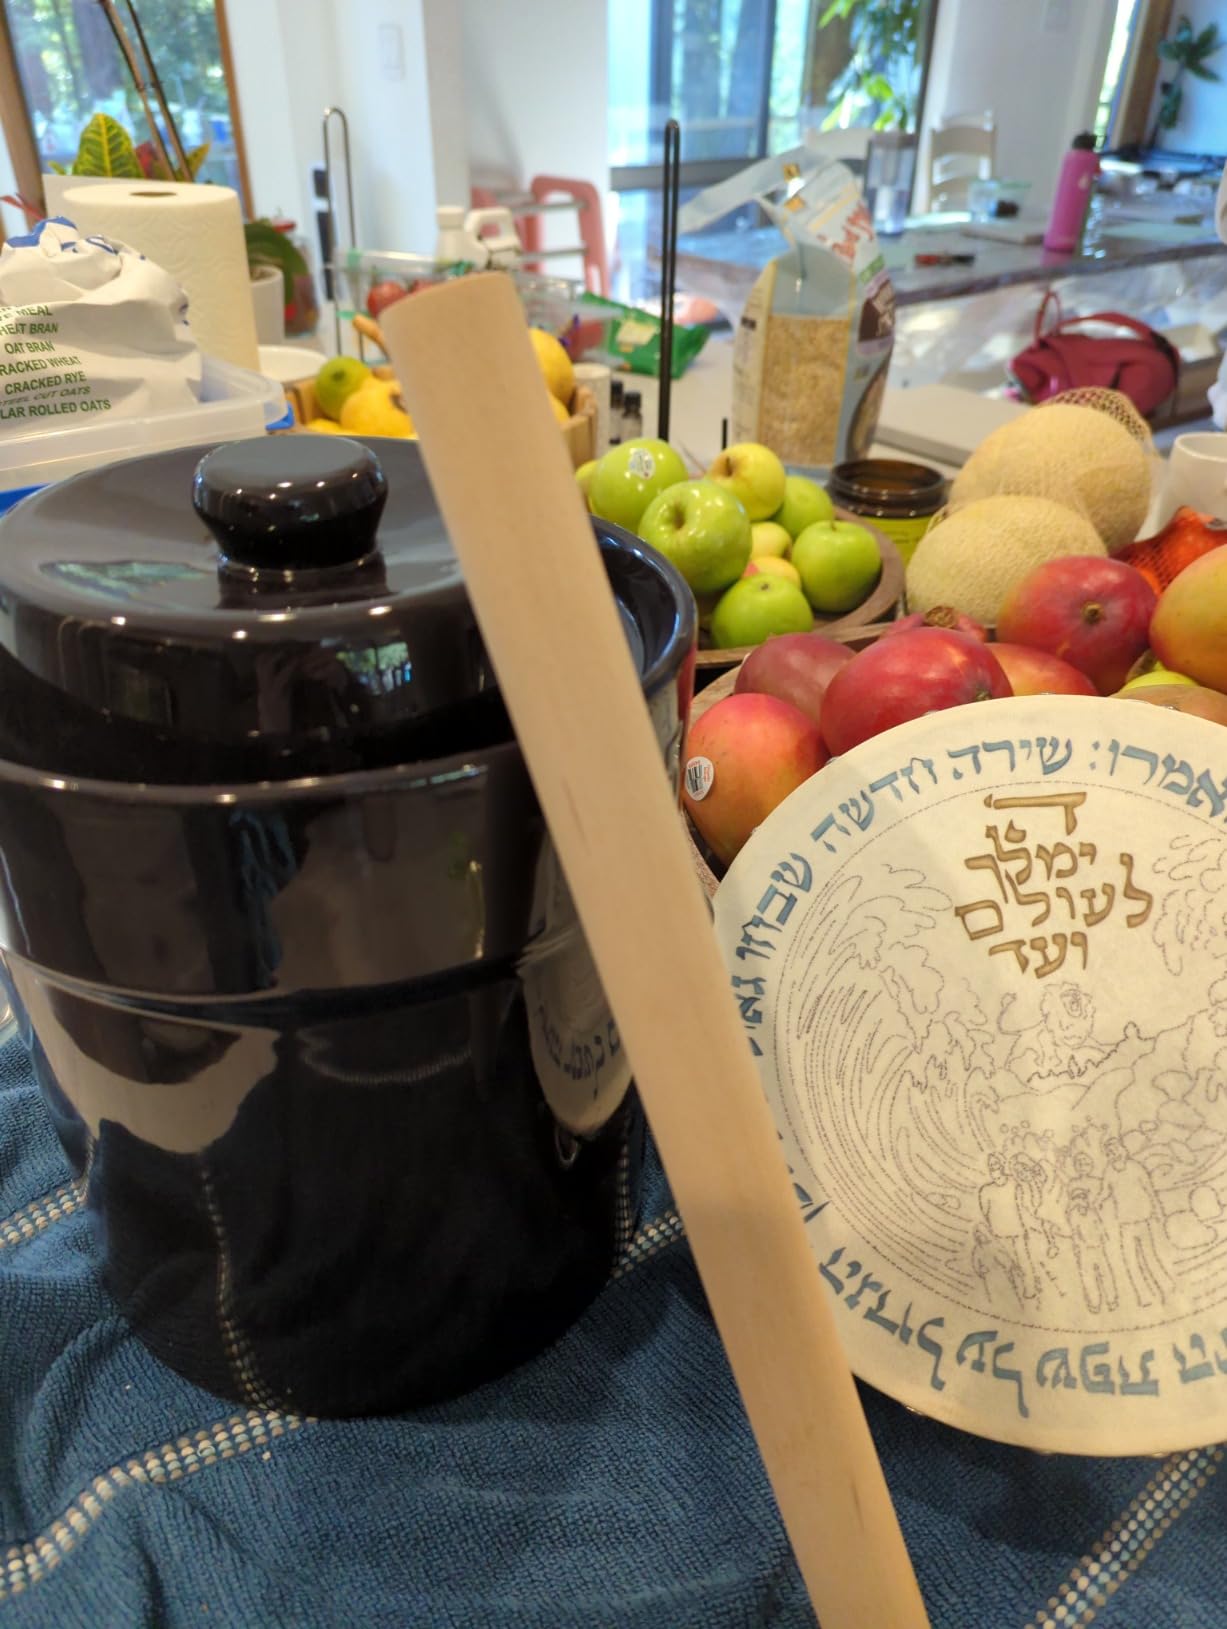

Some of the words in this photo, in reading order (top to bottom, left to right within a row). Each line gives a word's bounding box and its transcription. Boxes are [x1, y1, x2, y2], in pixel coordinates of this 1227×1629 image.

[29, 323, 58, 335] BRAN
[4, 342, 25, 354] OAT
[26, 340, 55, 353] BRAN
[47, 356, 82, 367] WHEAT
[4, 375, 62, 395] CRACKED
[64, 371, 87, 384] RYE
[60, 386, 91, 397] OATS
[29, 402, 78, 417] ROLLED
[80, 399, 112, 412] OATS
[948, 736, 1072, 780] שירה
[811, 758, 939, 852] חדשה
[736, 852, 813, 961] שבחו
[955, 853, 1153, 940] לעולם
[989, 932, 1088, 978] ועד
[820, 1247, 945, 1391] הגדול
[956, 1331, 1029, 1418] על
[1036, 1342, 1159, 1396] שפת
[1172, 1326, 1227, 1384] הי
